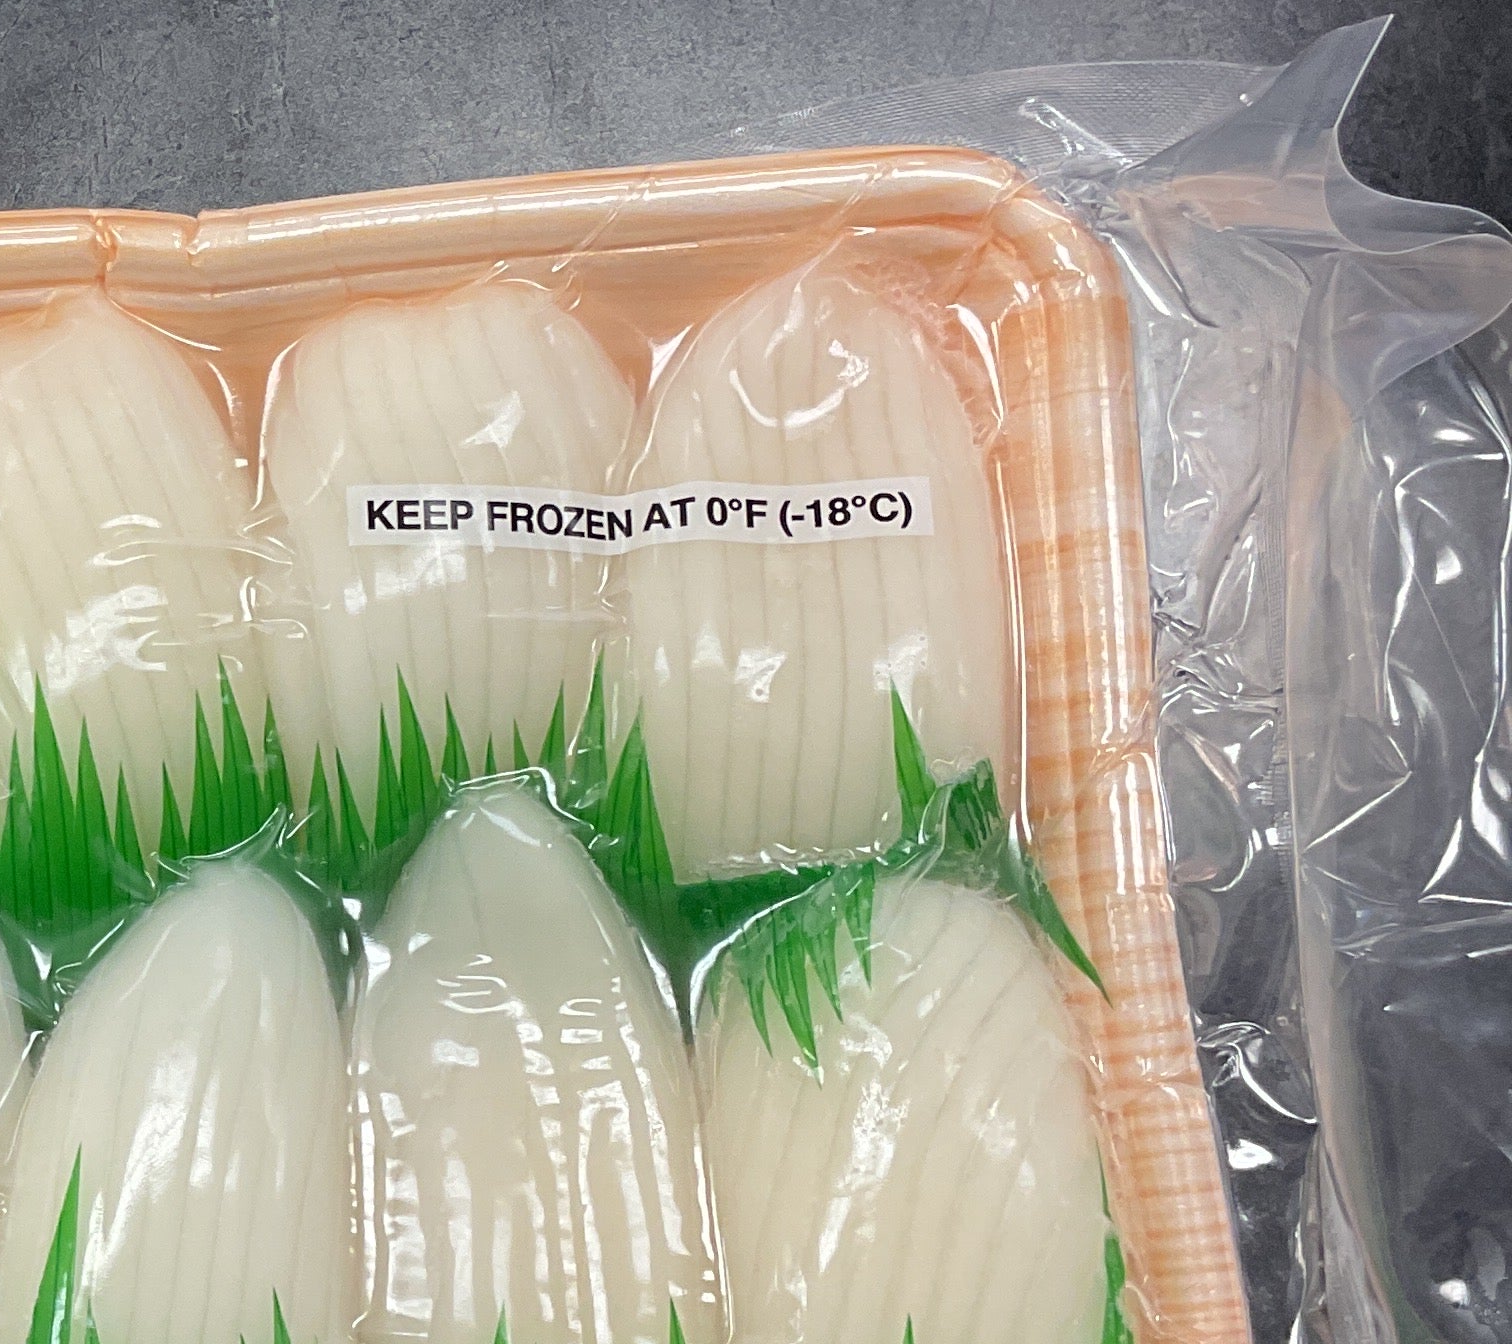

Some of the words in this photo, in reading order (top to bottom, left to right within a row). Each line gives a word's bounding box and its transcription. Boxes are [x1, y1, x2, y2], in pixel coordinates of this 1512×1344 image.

[366, 499, 474, 531] KEEP
[487, 501, 633, 541] FROZEN
[643, 497, 696, 533] AT
[707, 497, 768, 529] 0°F
[779, 491, 912, 537] (-18°C)
